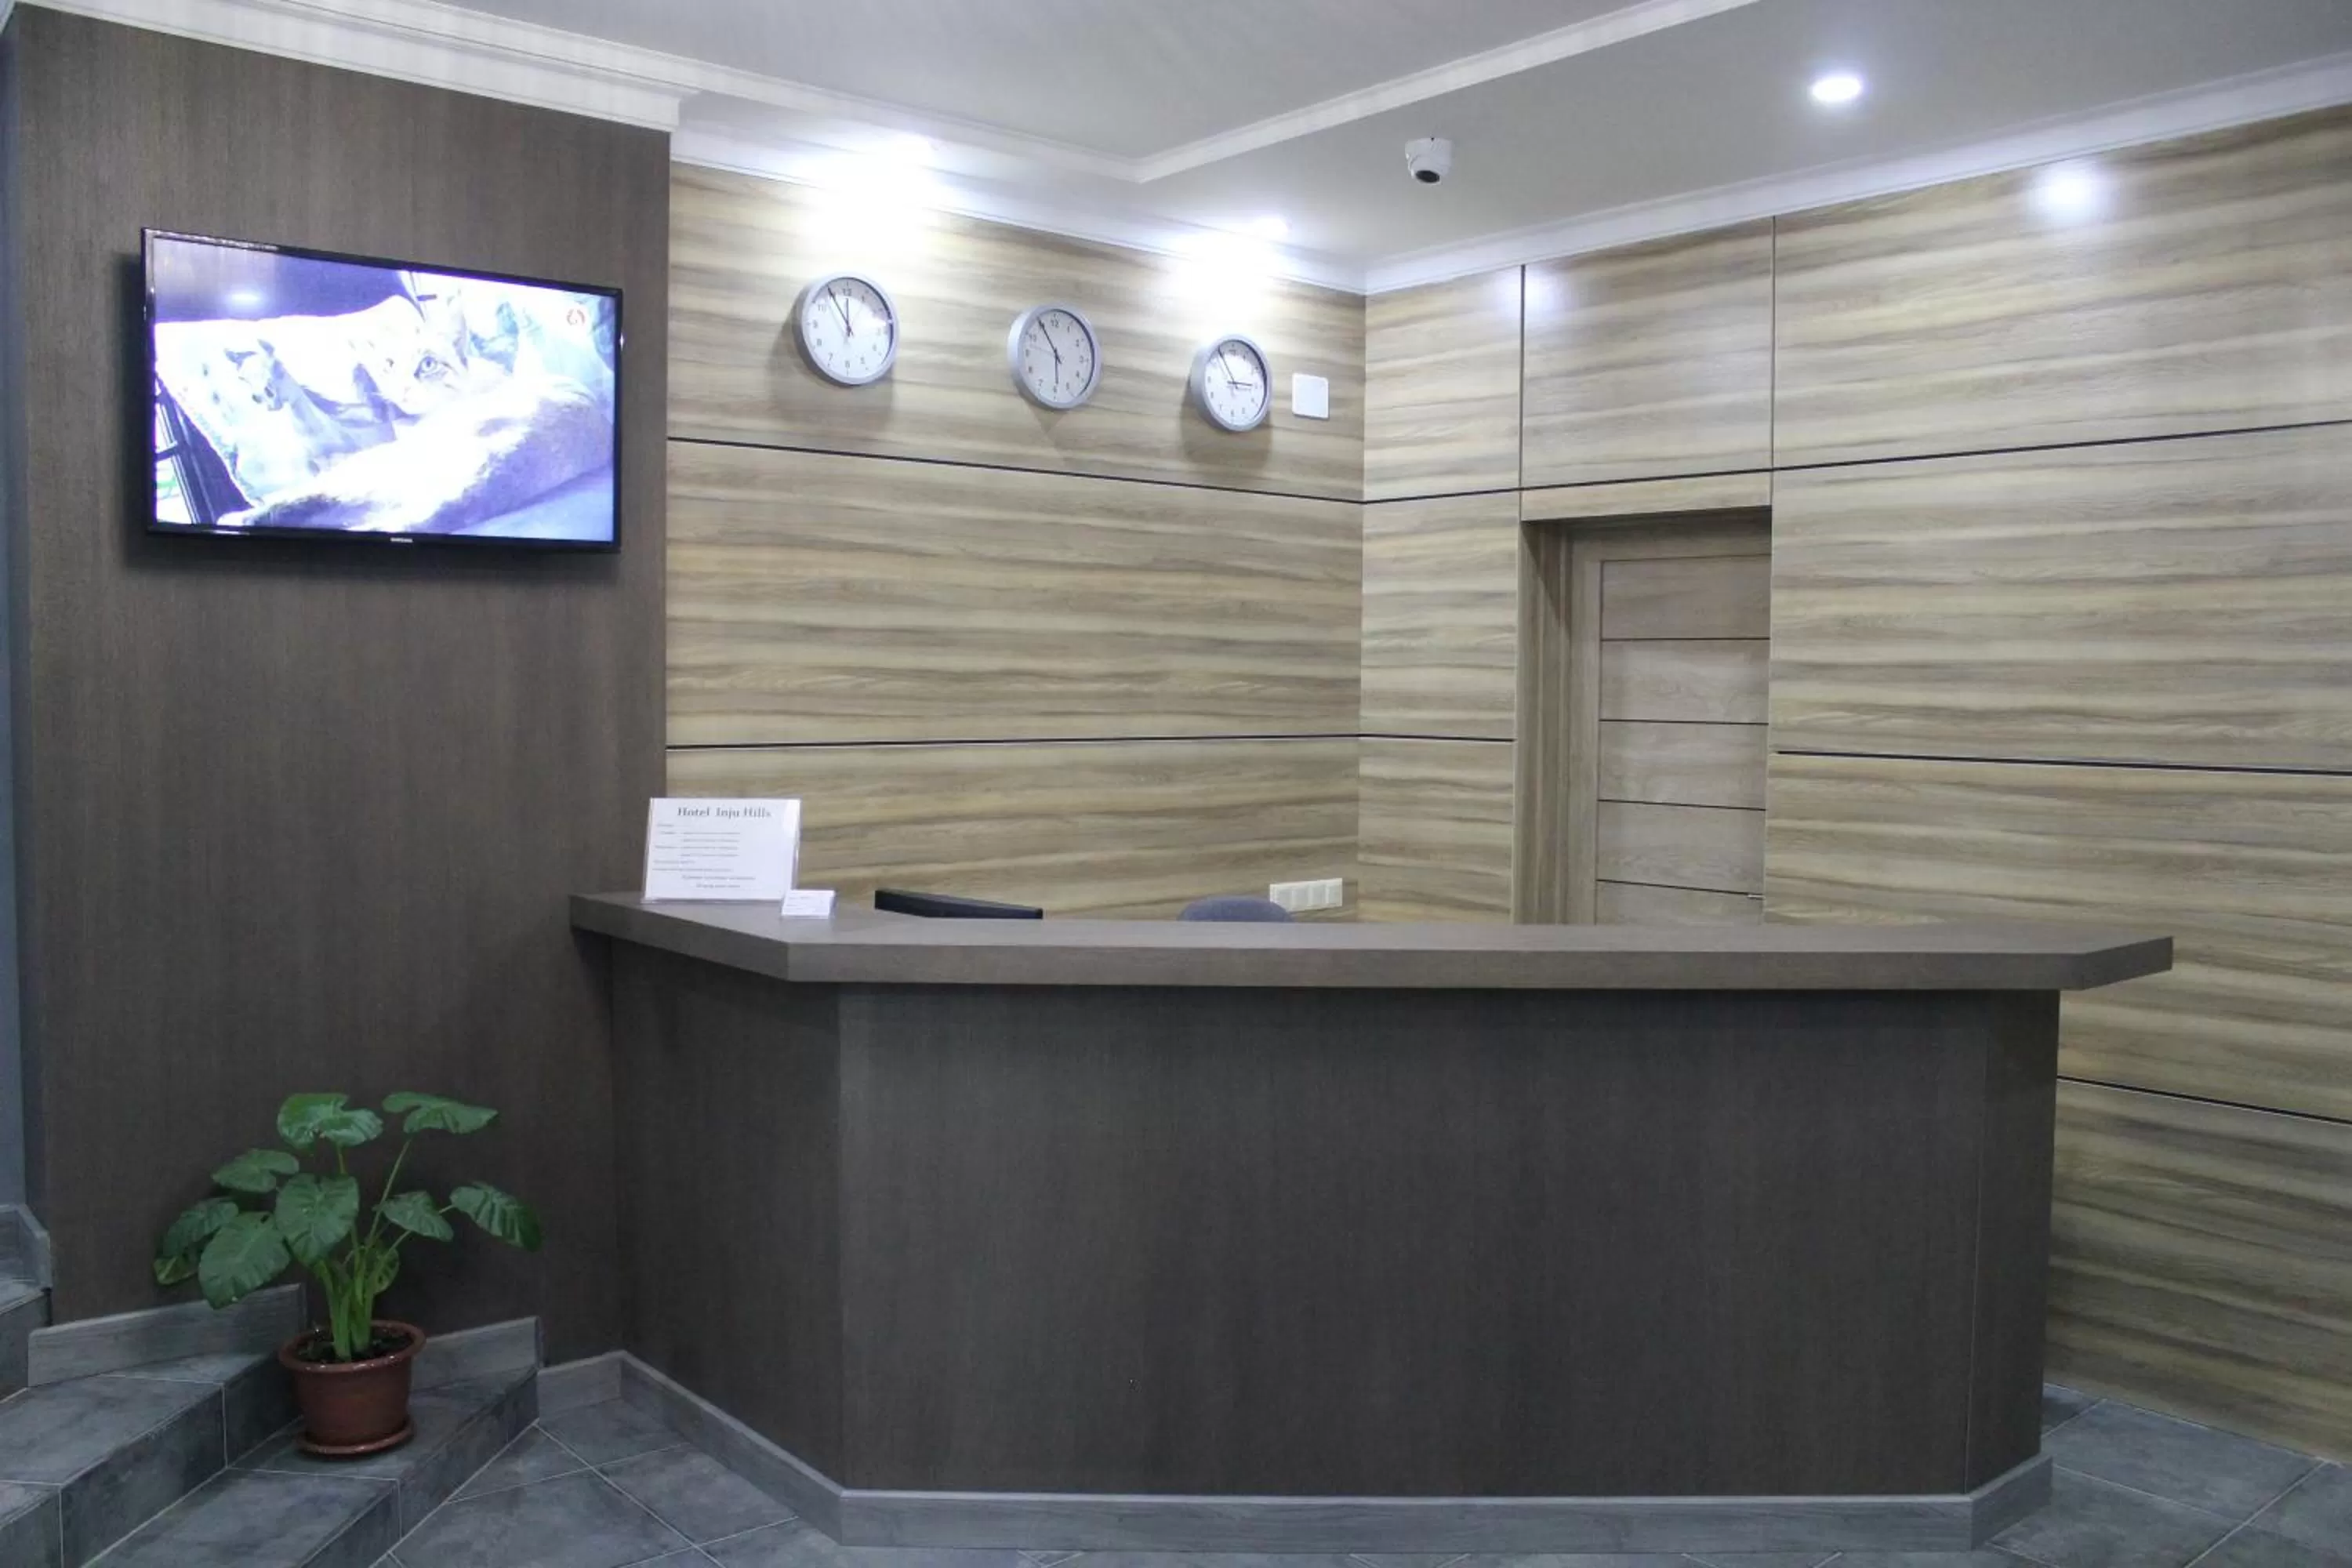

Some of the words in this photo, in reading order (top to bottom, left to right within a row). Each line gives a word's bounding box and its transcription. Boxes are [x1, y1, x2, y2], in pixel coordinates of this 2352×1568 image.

[677, 807, 710, 817] Hotel
[715, 807, 740, 820] Inju
[743, 807, 771, 818] Hills
